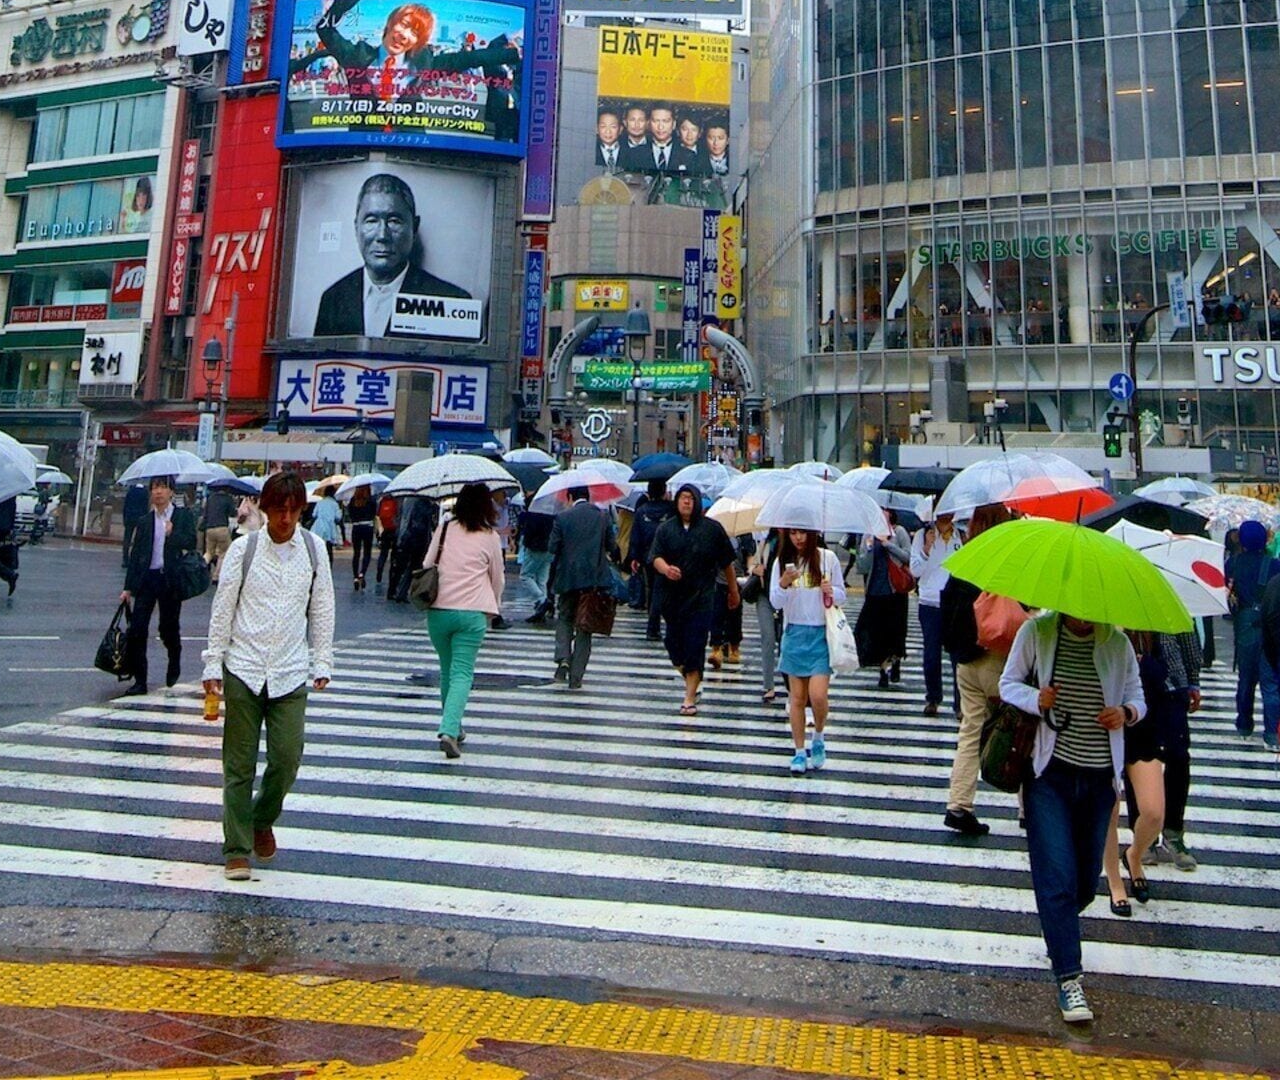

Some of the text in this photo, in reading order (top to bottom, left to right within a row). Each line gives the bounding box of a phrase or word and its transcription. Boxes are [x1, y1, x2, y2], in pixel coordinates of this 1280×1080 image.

[601, 29, 699, 59] 日本ダービー
[321, 100, 479, 118] 8/17(日) Zepp DiverCity
[529, 70, 549, 145] neon
[26, 216, 114, 241] Euphoria
[203, 206, 274, 316] クスリ
[918, 226, 1240, 266] STARBUCKS COFFEE
[115, 265, 146, 295] JTB
[395, 296, 480, 322] DMM.com
[721, 295, 736, 307] 4F
[284, 368, 478, 412] 大盛堂店
